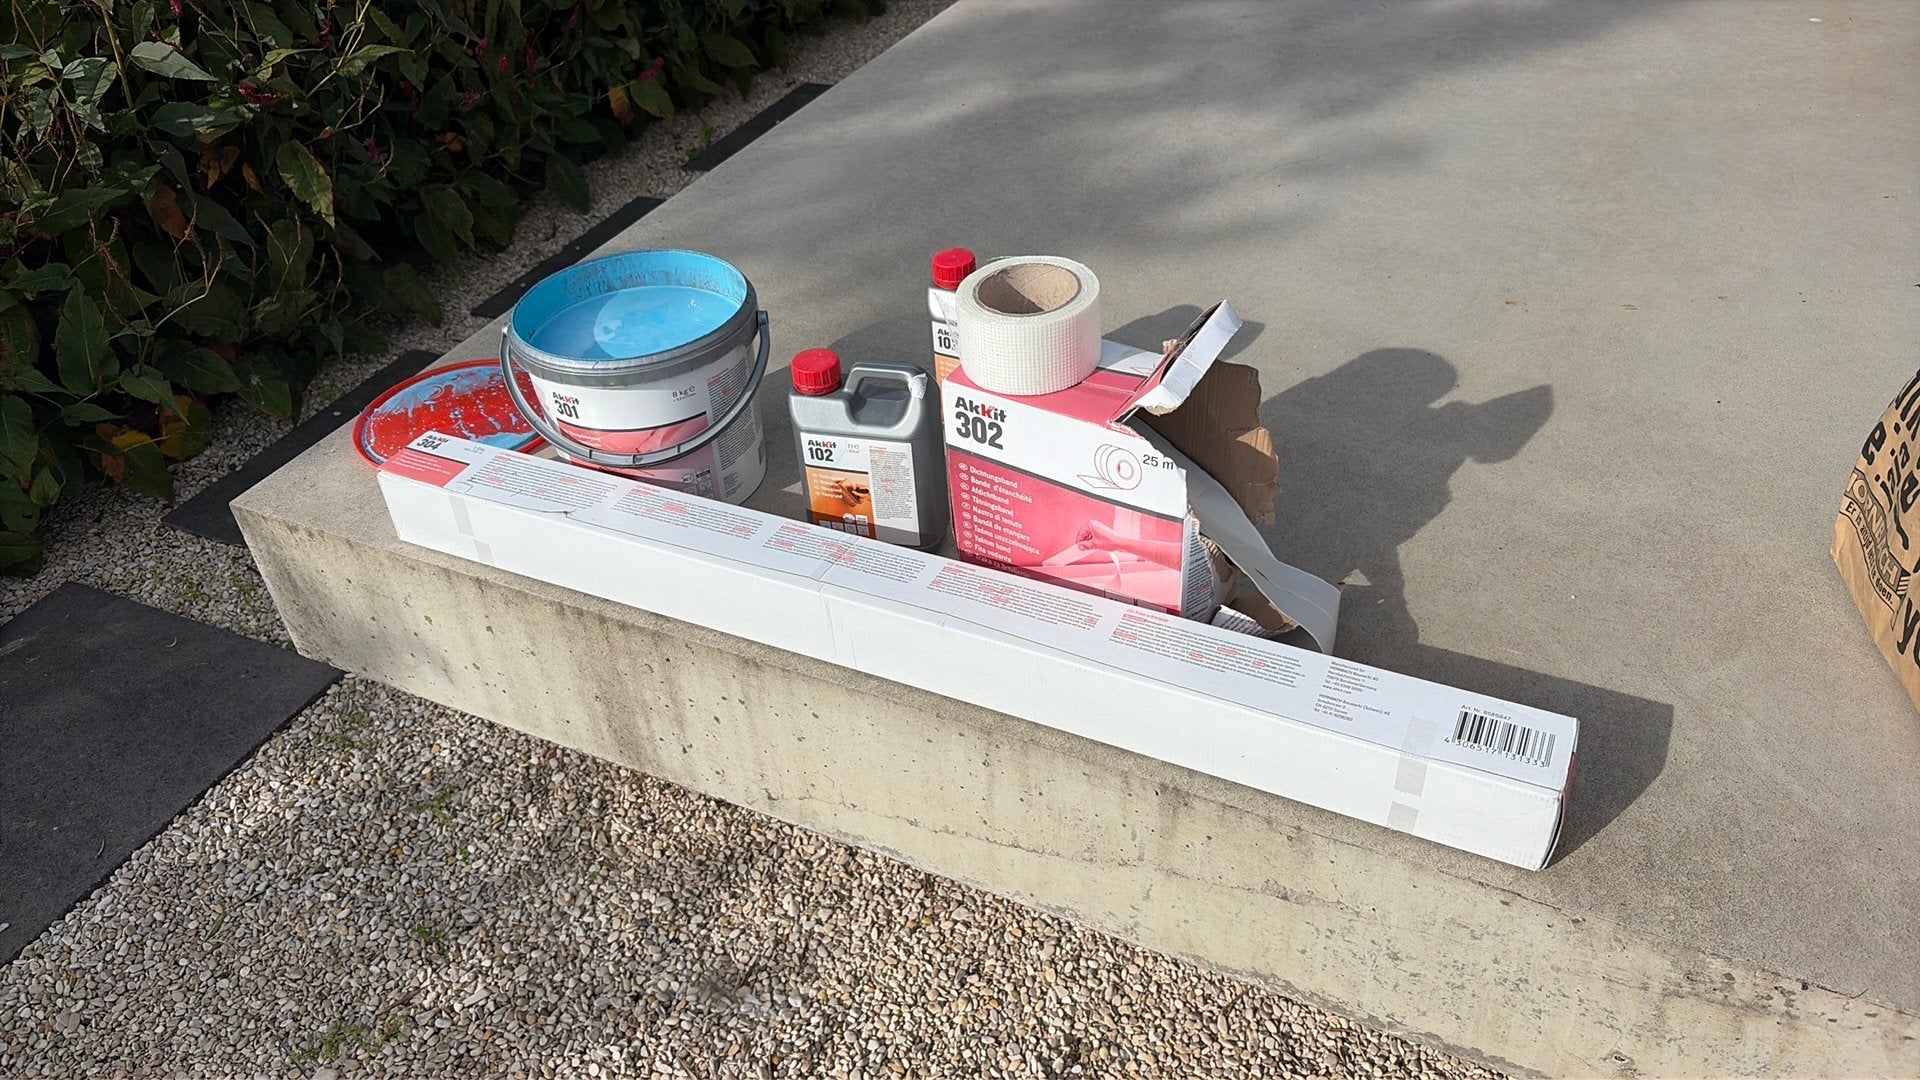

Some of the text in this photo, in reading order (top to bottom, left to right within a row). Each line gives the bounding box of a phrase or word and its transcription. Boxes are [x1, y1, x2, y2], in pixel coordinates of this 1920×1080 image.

[937, 335, 951, 349] 10
[552, 391, 580, 406] AkKit
[679, 388, 688, 397] kg
[554, 400, 580, 419] 301
[955, 396, 1007, 423] AkKit
[955, 411, 1004, 450] 302
[416, 438, 442, 450] 304
[808, 439, 837, 449] AkKit
[808, 447, 834, 462] 102
[1142, 454, 1174, 470] 25 m
[969, 466, 1018, 488] Dichtungsband
[1845, 472, 1899, 586] ORNBACH
